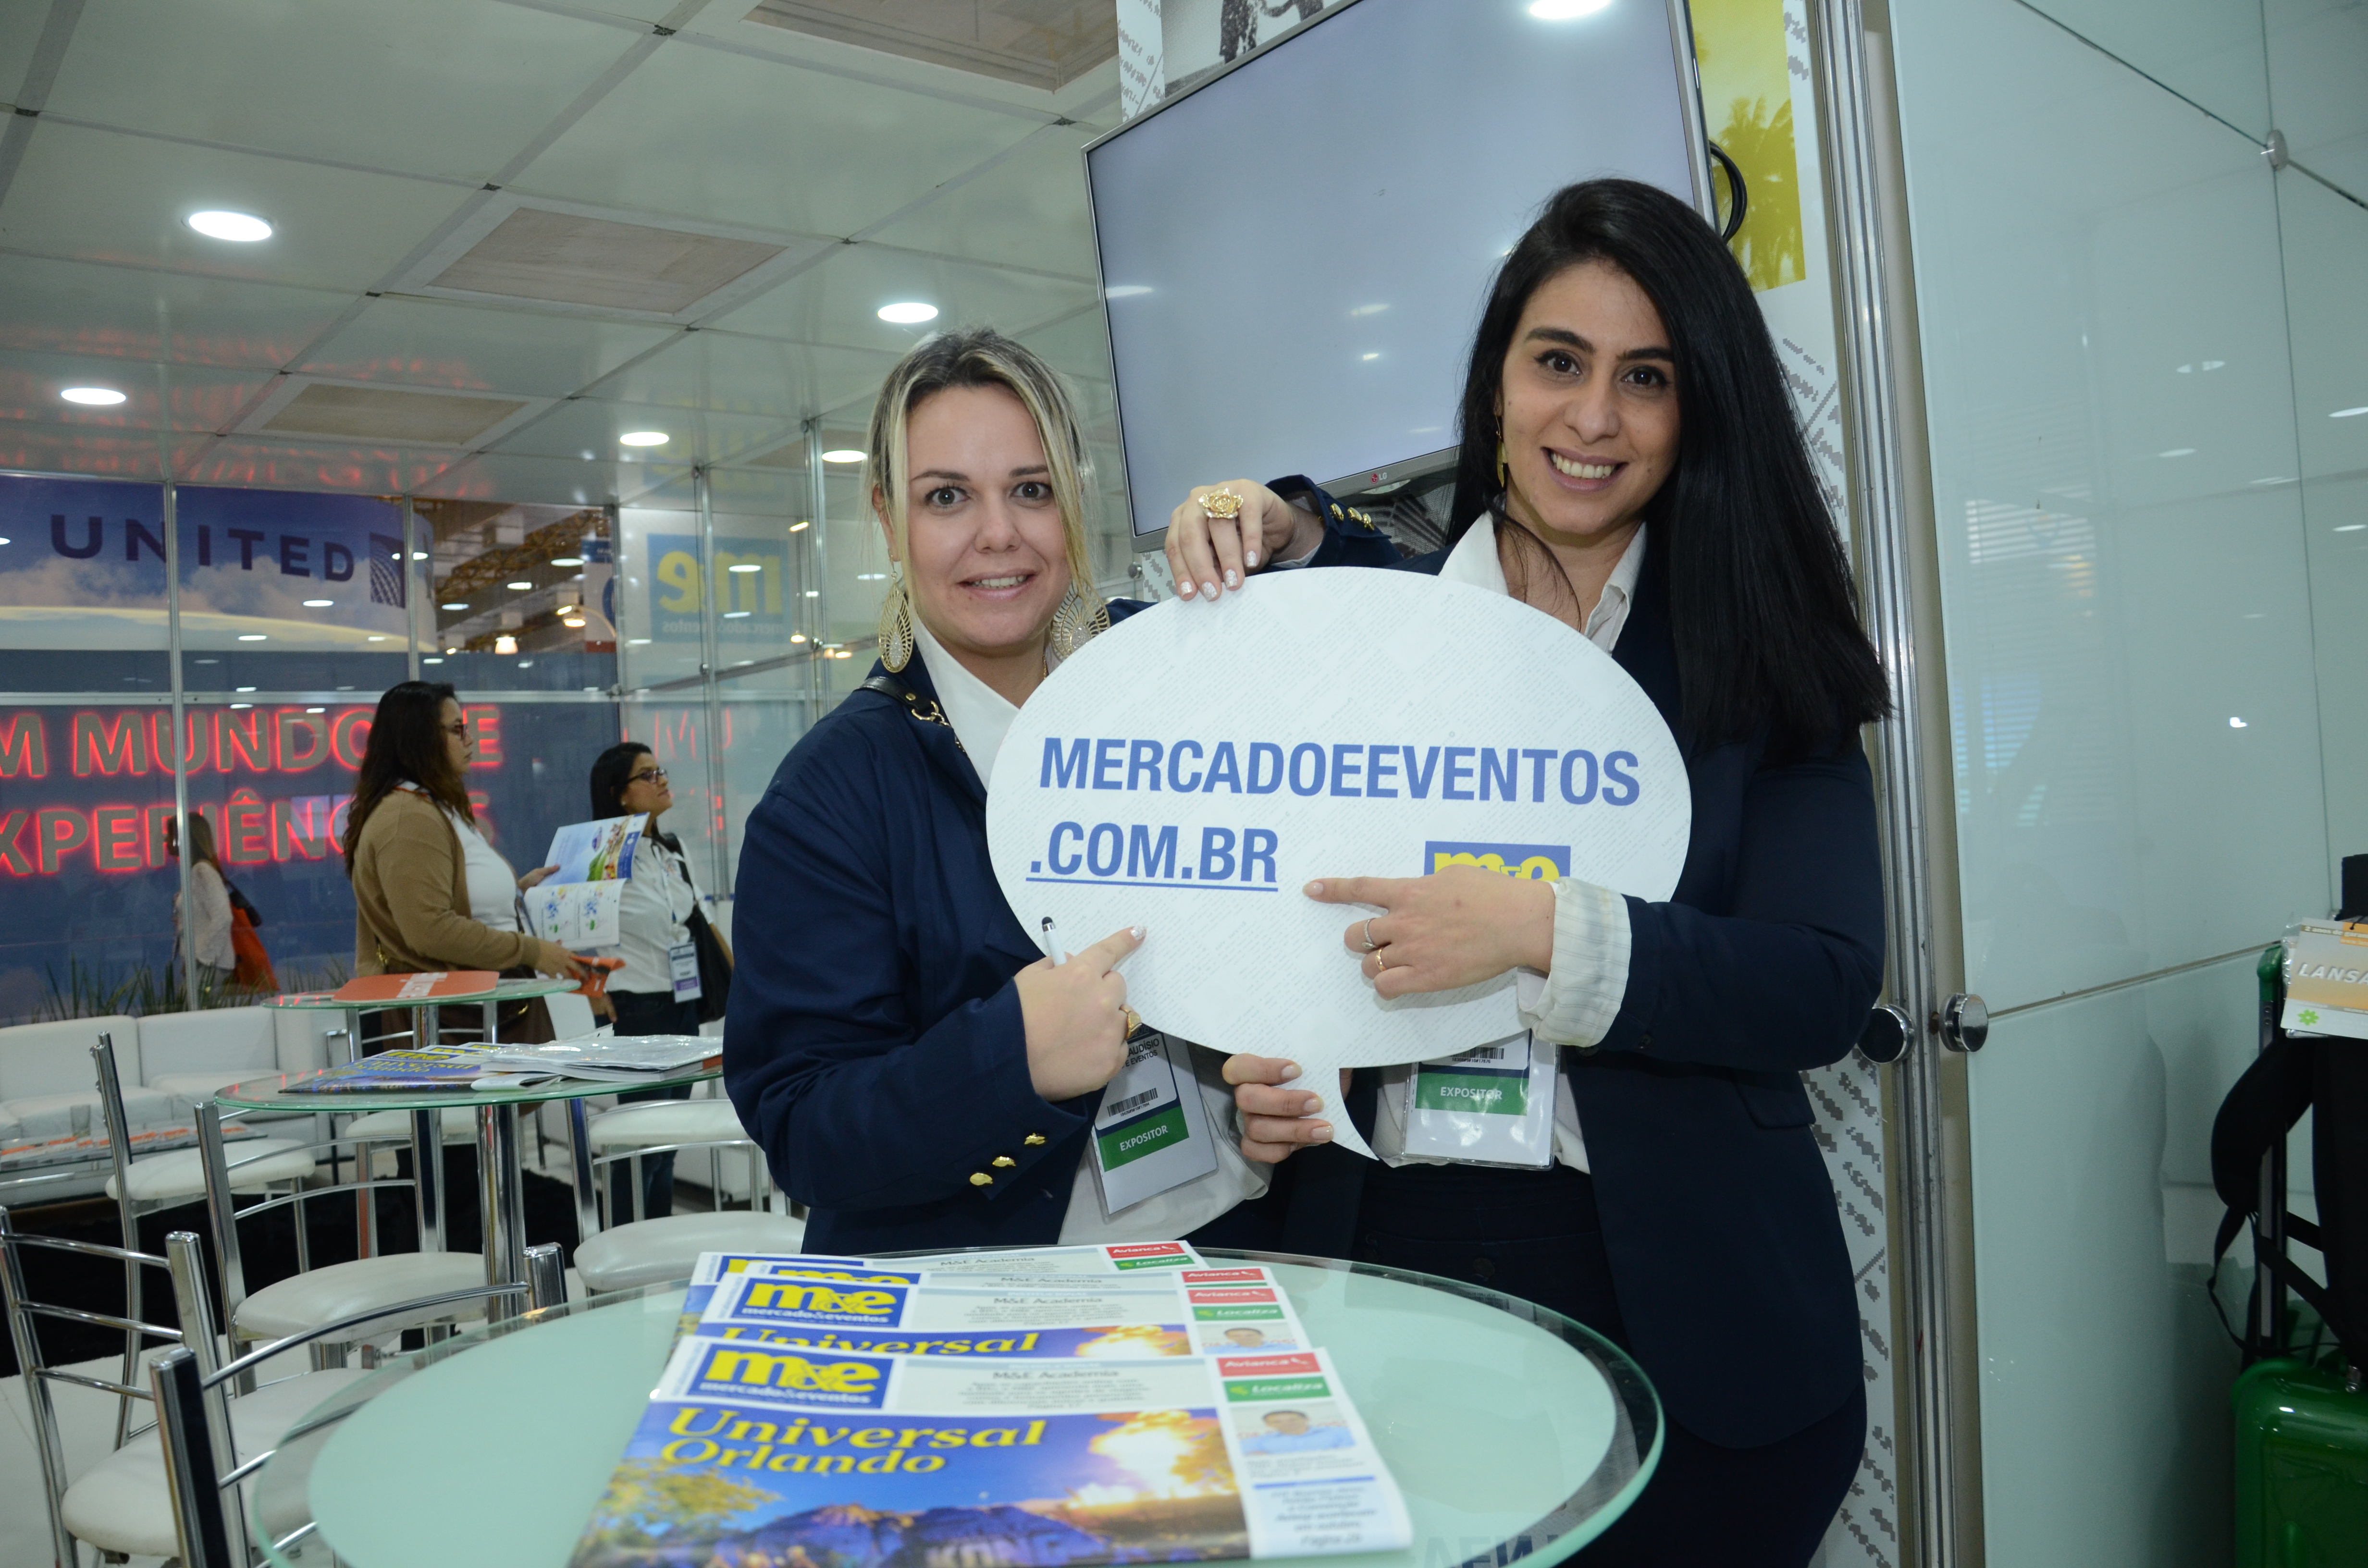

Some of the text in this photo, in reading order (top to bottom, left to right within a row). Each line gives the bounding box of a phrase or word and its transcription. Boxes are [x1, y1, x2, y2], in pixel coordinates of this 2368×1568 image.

[1379, 472, 1387, 480] LG
[50, 514, 355, 582] UNITED
[74, 709, 376, 776] MUNDO
[1039, 737, 1640, 806] MERCADOEEVENTOS
[1030, 821, 1277, 883] .COM.BR
[1131, 1050, 1158, 1065] EVENTOS
[1440, 1086, 1503, 1100] EXPOSITOR
[1119, 1125, 1168, 1152] EXPOSITOR
[1112, 1246, 1161, 1254] Avianca
[1135, 1256, 1188, 1266] Localiza
[745, 1283, 897, 1315] m&e
[741, 1308, 889, 1323] mercado&eventos
[1216, 1308, 1278, 1316] Localiza
[1224, 1359, 1290, 1368] Avianca
[703, 1350, 881, 1394] m&e
[1038, 1370, 1120, 1379] Academia
[1251, 1382, 1323, 1392] Localiza
[668, 1407, 1047, 1448] Universal
[660, 1437, 946, 1473] Orlando
